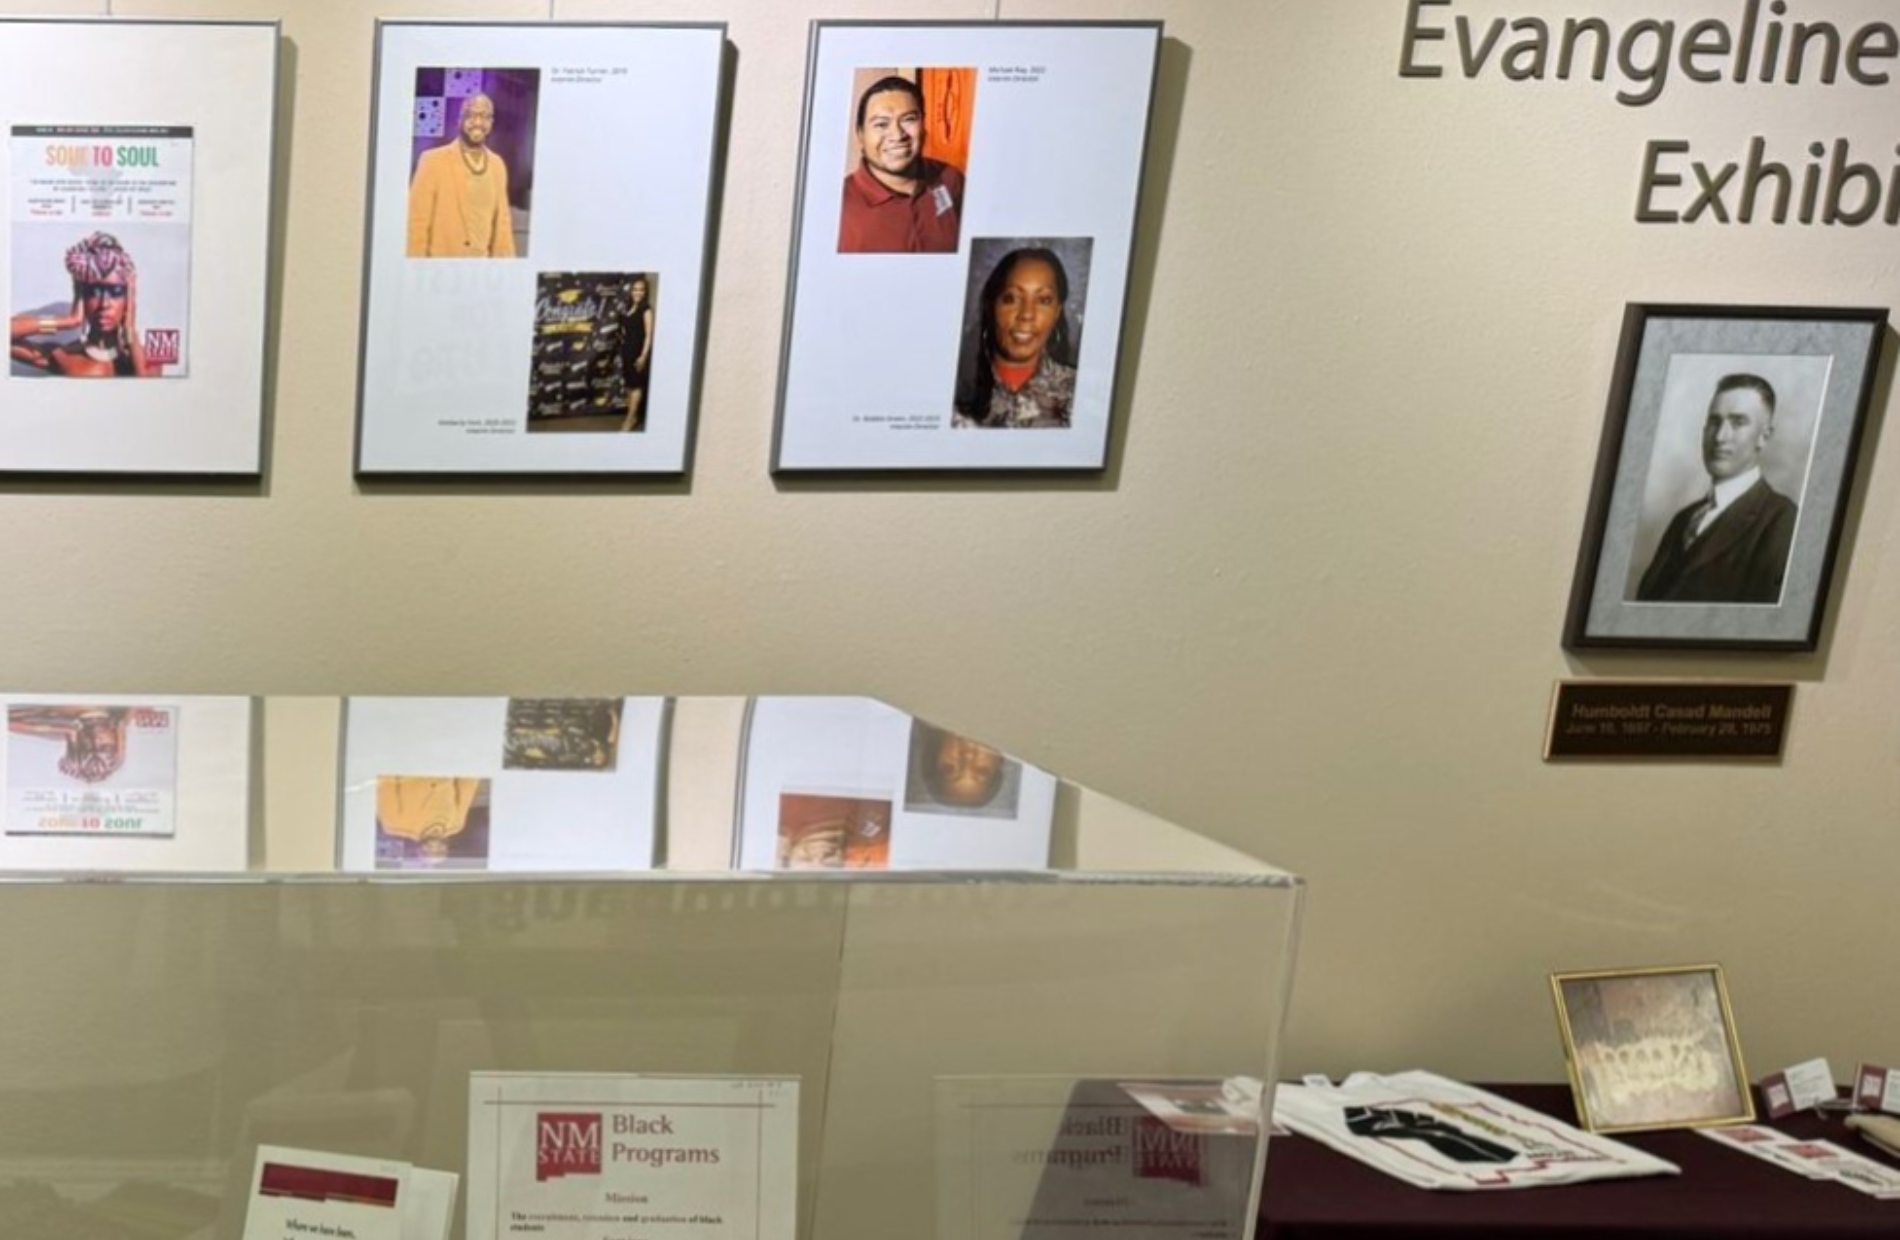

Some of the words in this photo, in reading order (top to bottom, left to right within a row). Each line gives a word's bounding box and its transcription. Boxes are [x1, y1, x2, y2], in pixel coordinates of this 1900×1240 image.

[1398, 0, 1898, 106] Evangeline
[93, 146, 113, 166] TO
[117, 146, 159, 166] SOUL
[147, 331, 177, 347] NM
[1572, 703, 1650, 719] Humboldt
[1654, 704, 1705, 719] Casad
[1709, 704, 1772, 719] Mandell
[612, 1113, 674, 1135] Black
[538, 1121, 600, 1148] NM
[538, 1149, 599, 1165] STATE
[611, 1143, 720, 1167] Programs
[605, 1192, 649, 1204] Mission
[285, 1218, 308, 1232] Where
[320, 1224, 334, 1235] have
[511, 1212, 527, 1222] The
[623, 1214, 638, 1223] and
[689, 1215, 698, 1224] of
[699, 1215, 723, 1224] black
